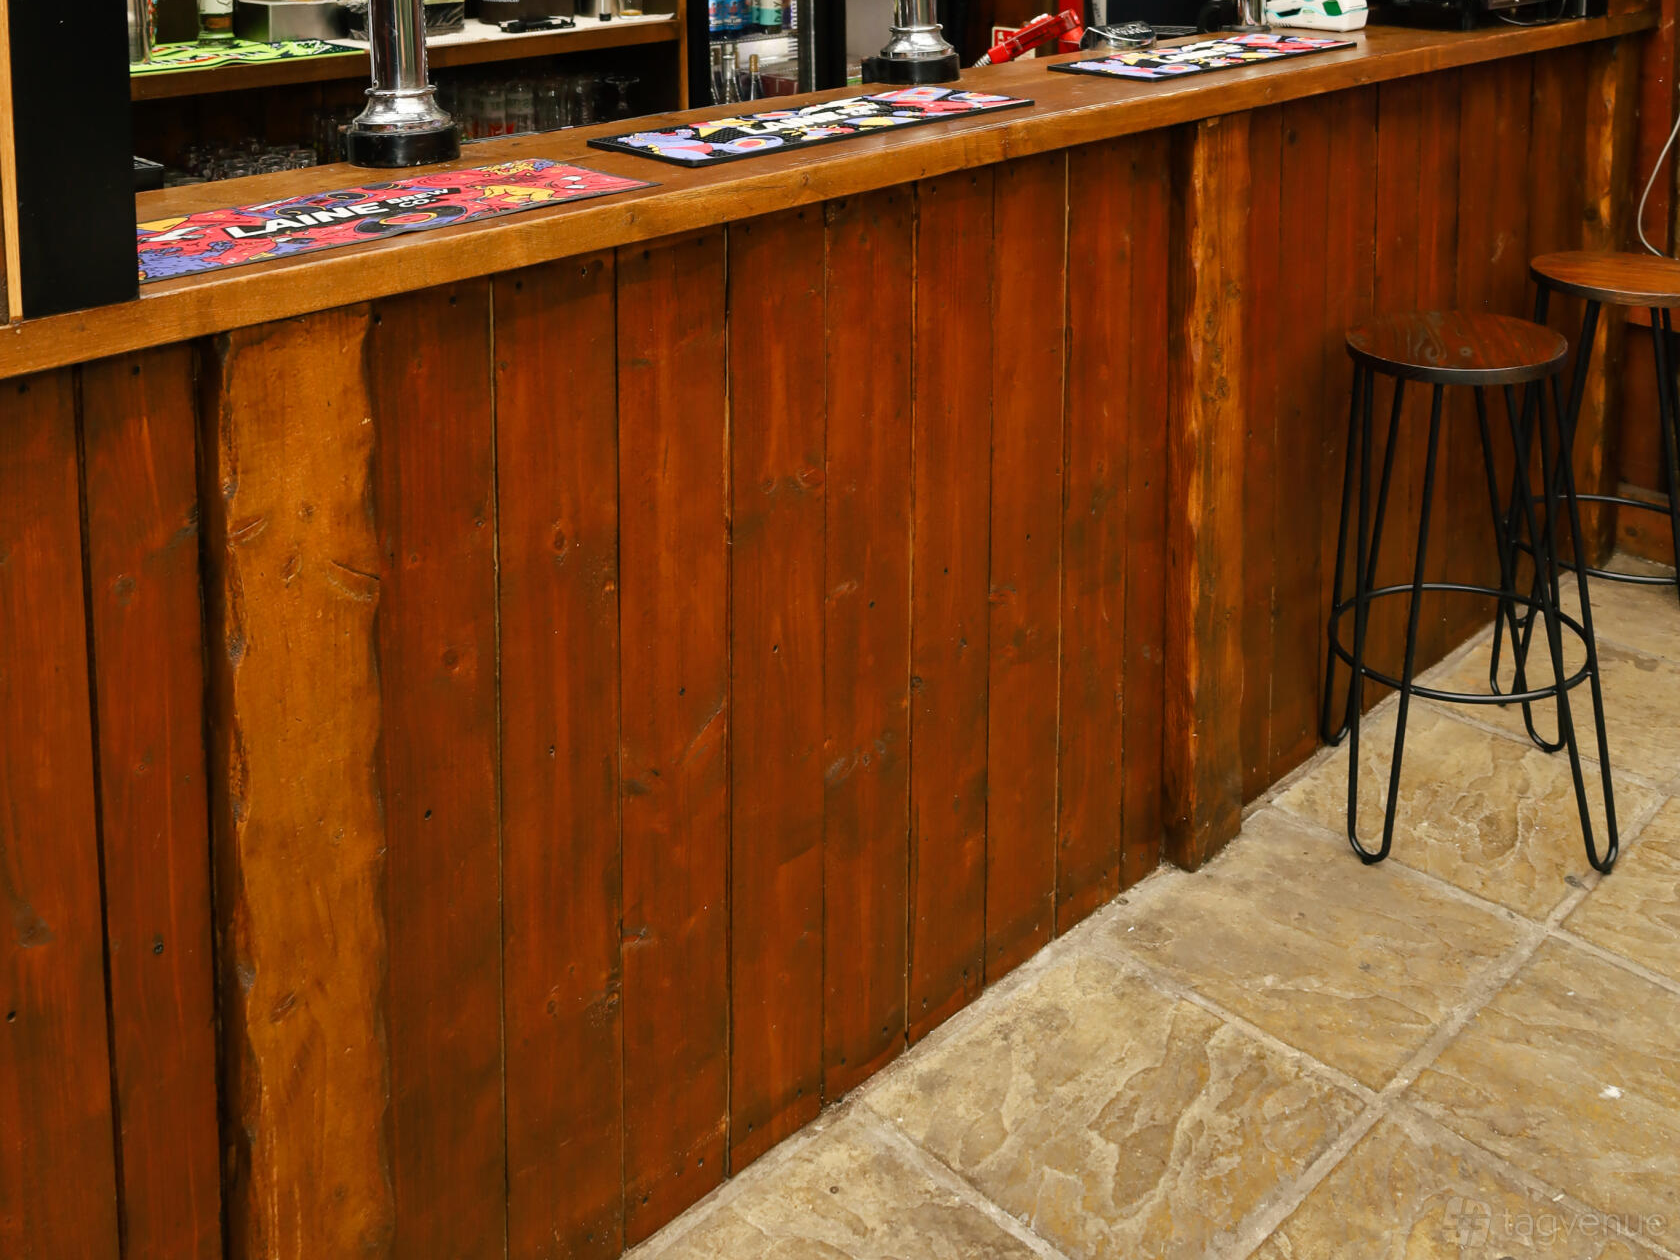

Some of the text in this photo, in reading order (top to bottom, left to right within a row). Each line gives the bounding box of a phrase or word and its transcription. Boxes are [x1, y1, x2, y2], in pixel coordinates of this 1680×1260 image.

[224, 201, 389, 239] LAINE
[385, 187, 450, 205] BREW
[398, 197, 435, 209] CO.
